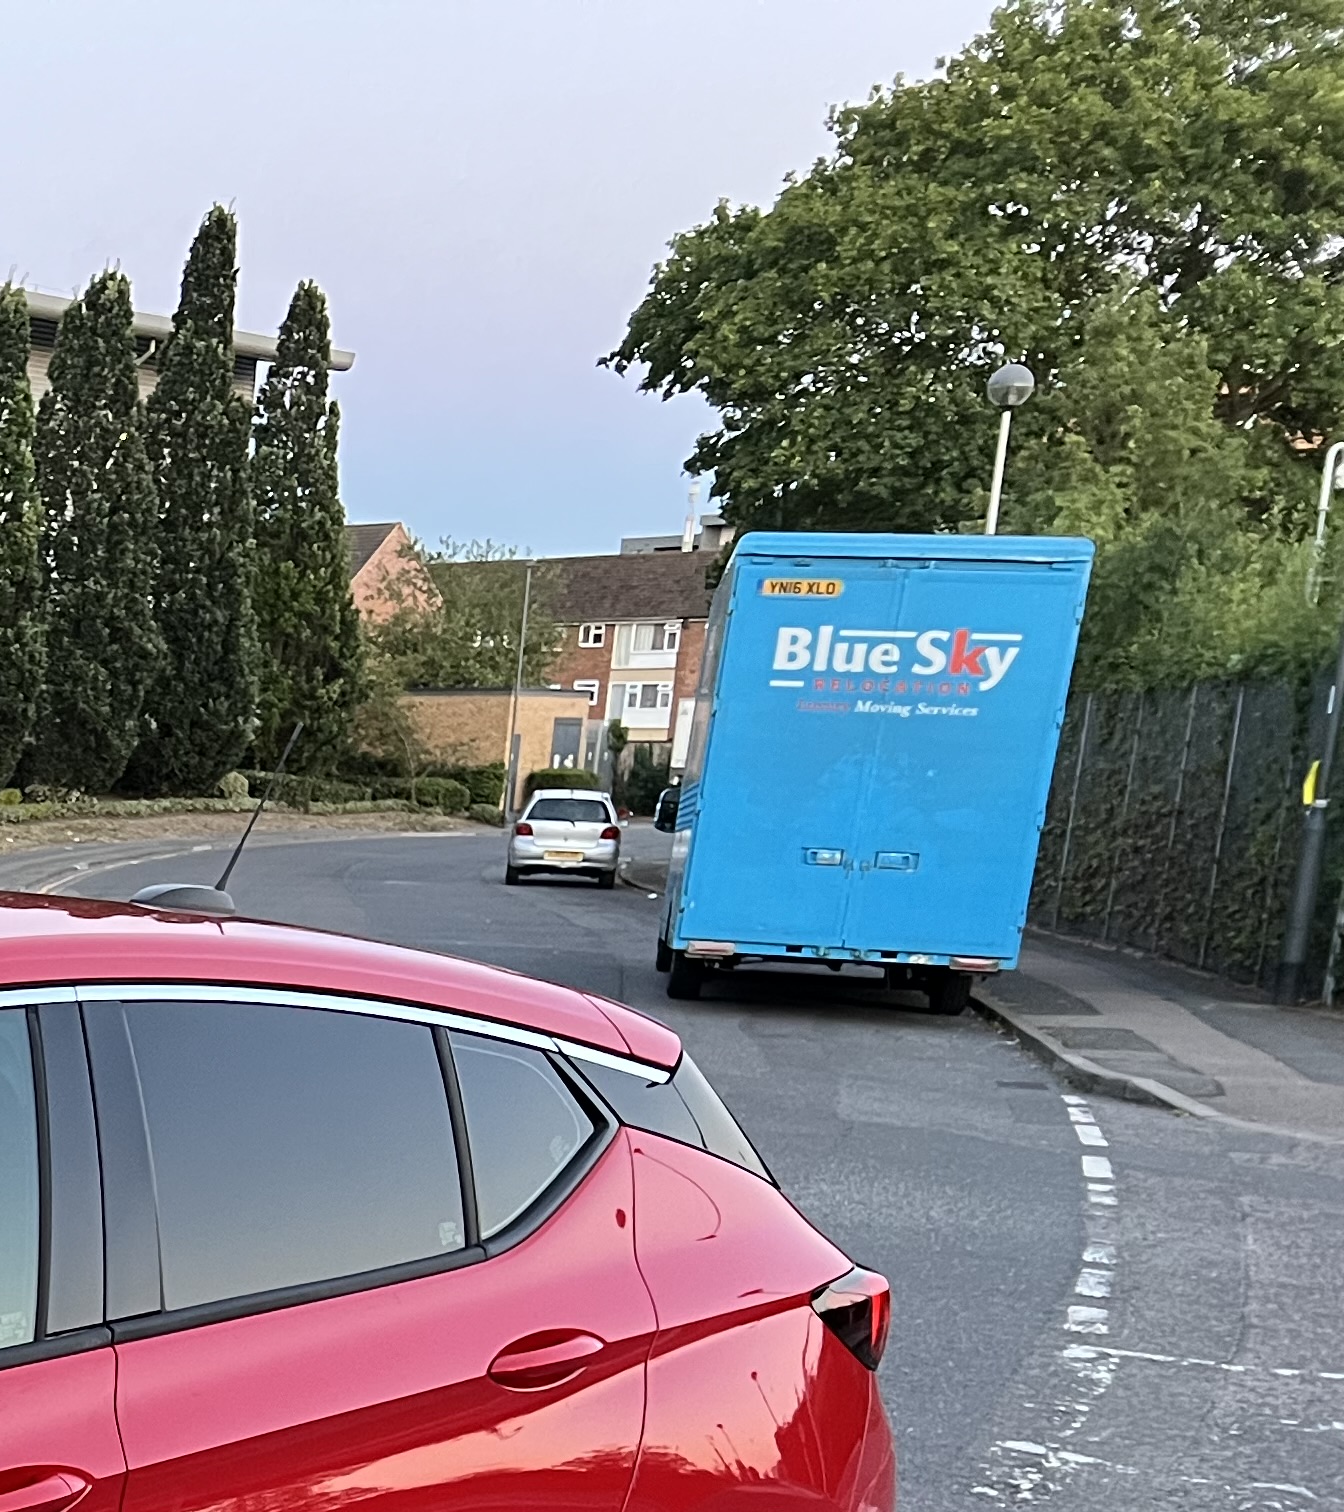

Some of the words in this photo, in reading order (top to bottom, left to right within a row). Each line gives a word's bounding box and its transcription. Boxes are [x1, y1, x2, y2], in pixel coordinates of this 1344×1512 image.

[769, 581, 802, 595] YN16
[806, 582, 837, 595] XLO
[773, 625, 900, 674] Blue
[911, 629, 1020, 691] Sky
[813, 679, 971, 695] RELOCATION
[854, 700, 912, 717] Moving
[915, 702, 979, 717] Services
